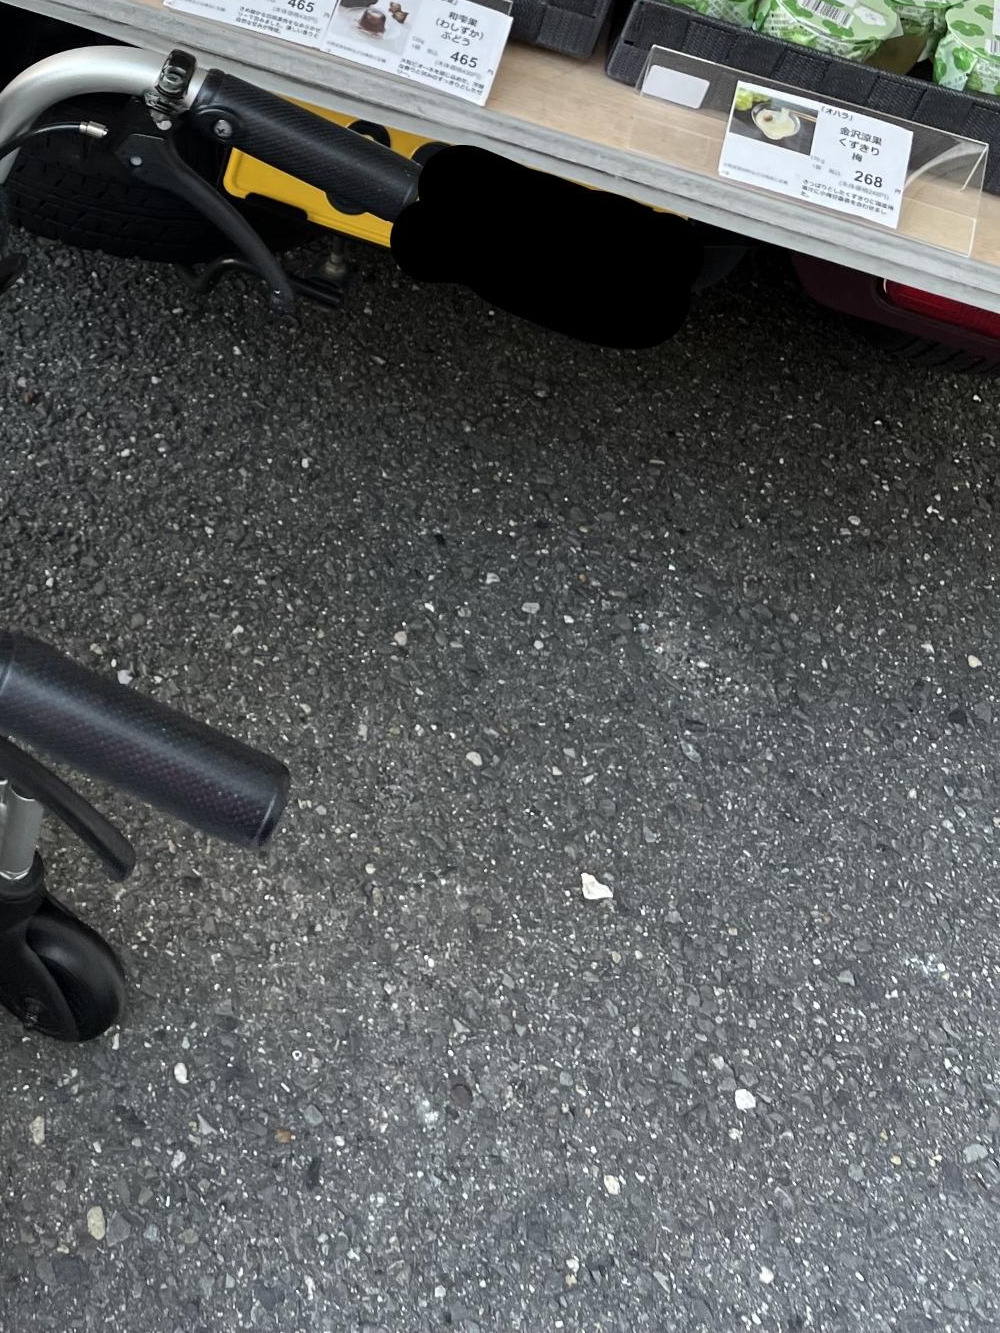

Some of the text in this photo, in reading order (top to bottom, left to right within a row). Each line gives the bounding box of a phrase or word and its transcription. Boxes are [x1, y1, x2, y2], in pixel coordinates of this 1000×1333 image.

[435, 18, 485, 41] (わしずか)
[441, 31, 471, 47] ぶどう
[450, 51, 478, 68] 465
[821, 105, 853, 121] 「オハラ」
[840, 127, 882, 146] 金沢涼果
[852, 153, 863, 163] 梅
[854, 171, 883, 188] 268
